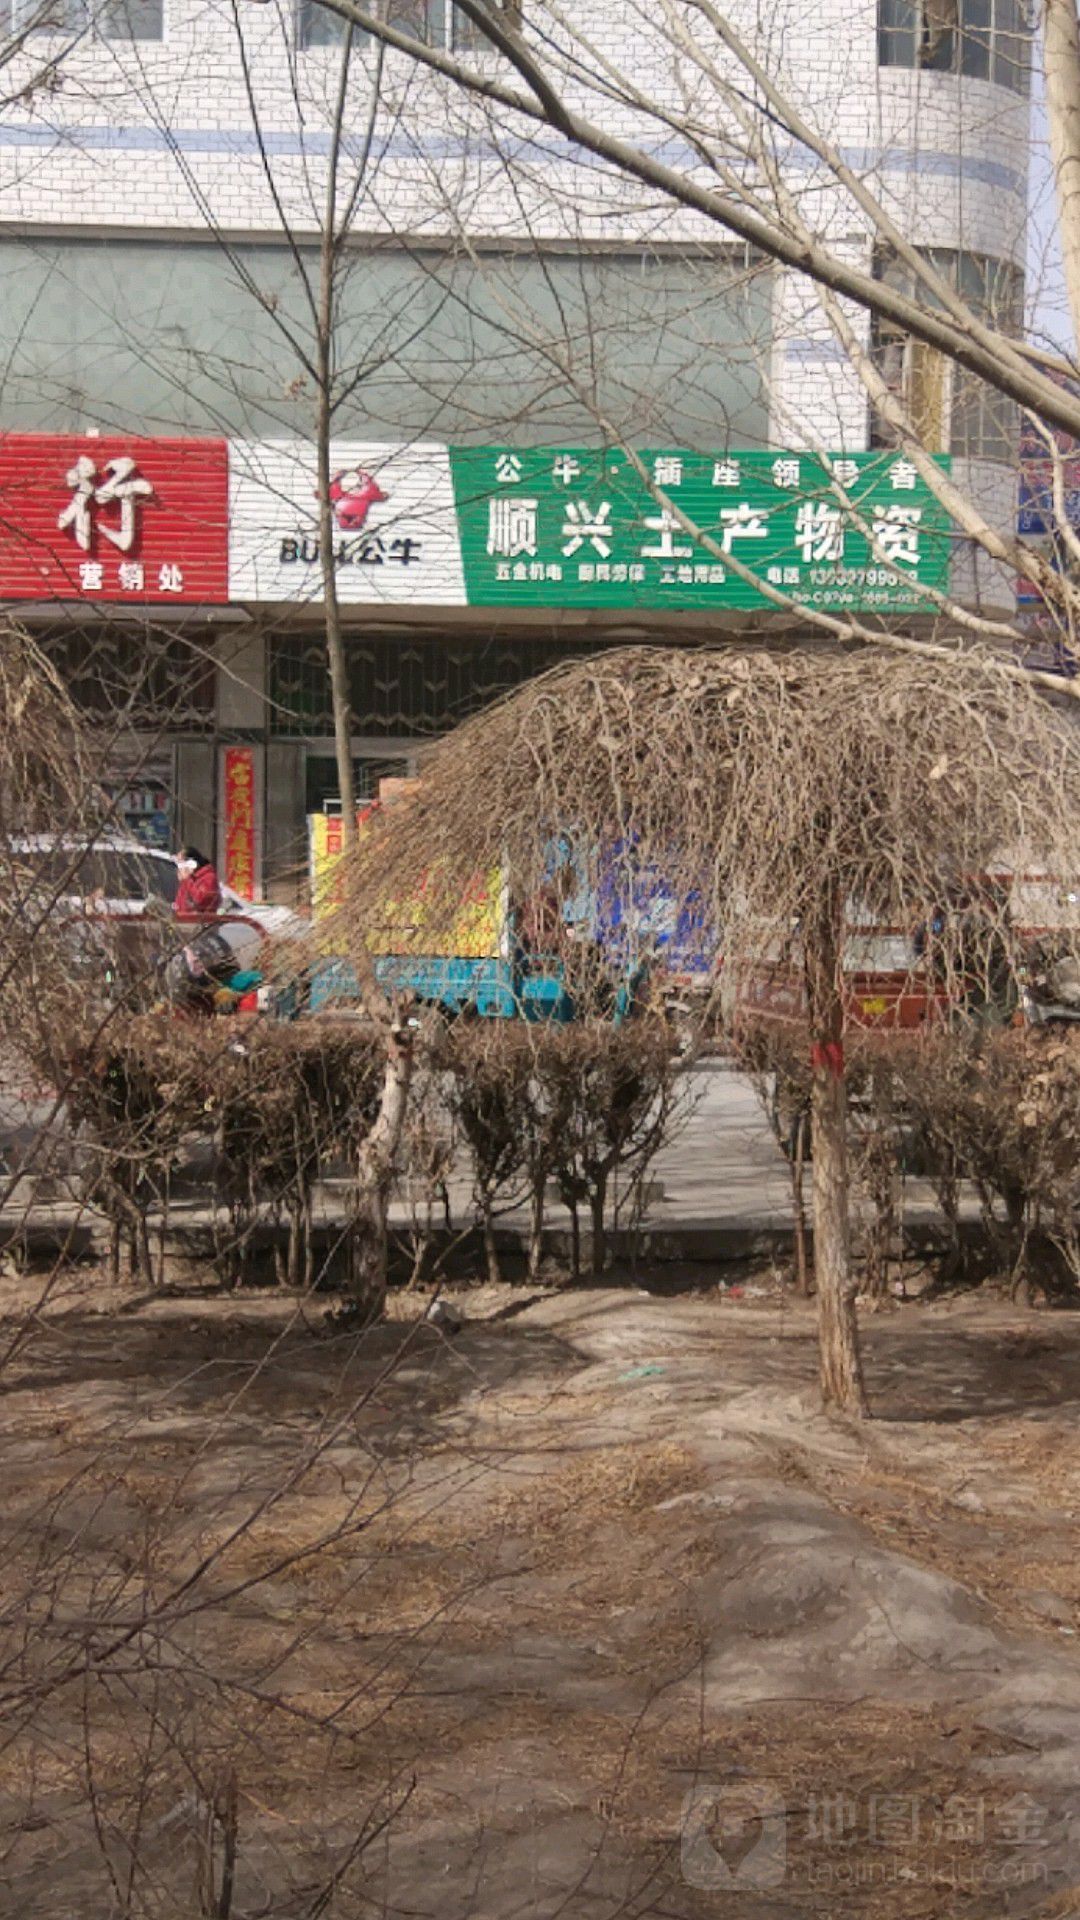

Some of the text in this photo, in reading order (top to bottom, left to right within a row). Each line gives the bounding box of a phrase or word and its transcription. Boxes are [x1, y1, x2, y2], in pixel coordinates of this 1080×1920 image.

[58, 456, 154, 552] 行
[487, 498, 922, 564] 顺兴土产物资
[280, 537, 422, 566] BUL公牛
[79, 563, 184, 593] 营销处
[767, 566, 800, 584] 电话
